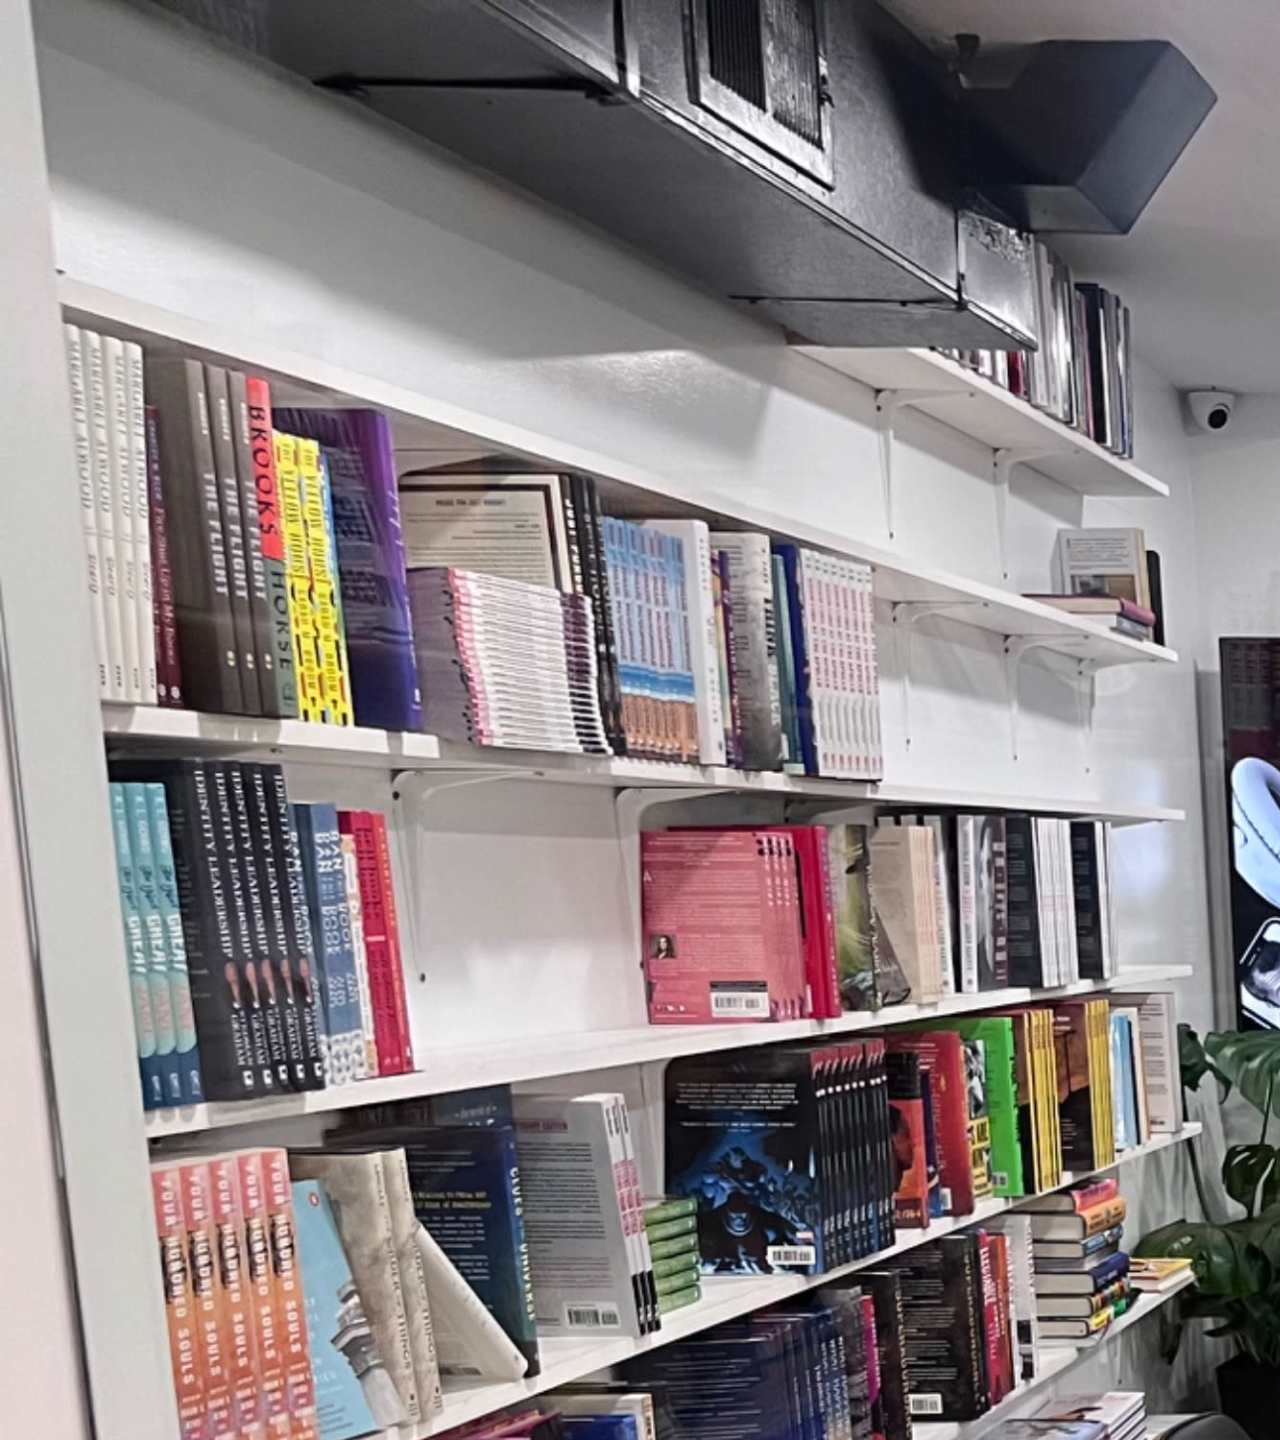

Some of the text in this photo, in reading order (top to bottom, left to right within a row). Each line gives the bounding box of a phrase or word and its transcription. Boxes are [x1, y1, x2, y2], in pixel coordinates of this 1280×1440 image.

[203, 474, 229, 597] THE FLIGHT
[224, 478, 248, 600] THE FLIGHT
[247, 405, 293, 669] BROOKS HORSE
[194, 770, 216, 850] IDENTITY
[208, 856, 233, 957] LEADERSHIP
[215, 772, 235, 851] IDENTITY
[229, 857, 252, 958] LEADERSHIP
[232, 771, 252, 850] IDENTITY
[245, 856, 268, 954] LEADERSHIP
[253, 773, 272, 852] IDENTITY
[265, 857, 287, 955] LEADERSHIP
[177, 1328, 195, 1384] SOULS
[204, 1321, 222, 1376] SOULS
[231, 1312, 249, 1367] SOULS
[259, 1306, 276, 1360] SOULS
[285, 1300, 302, 1354] SOULS
